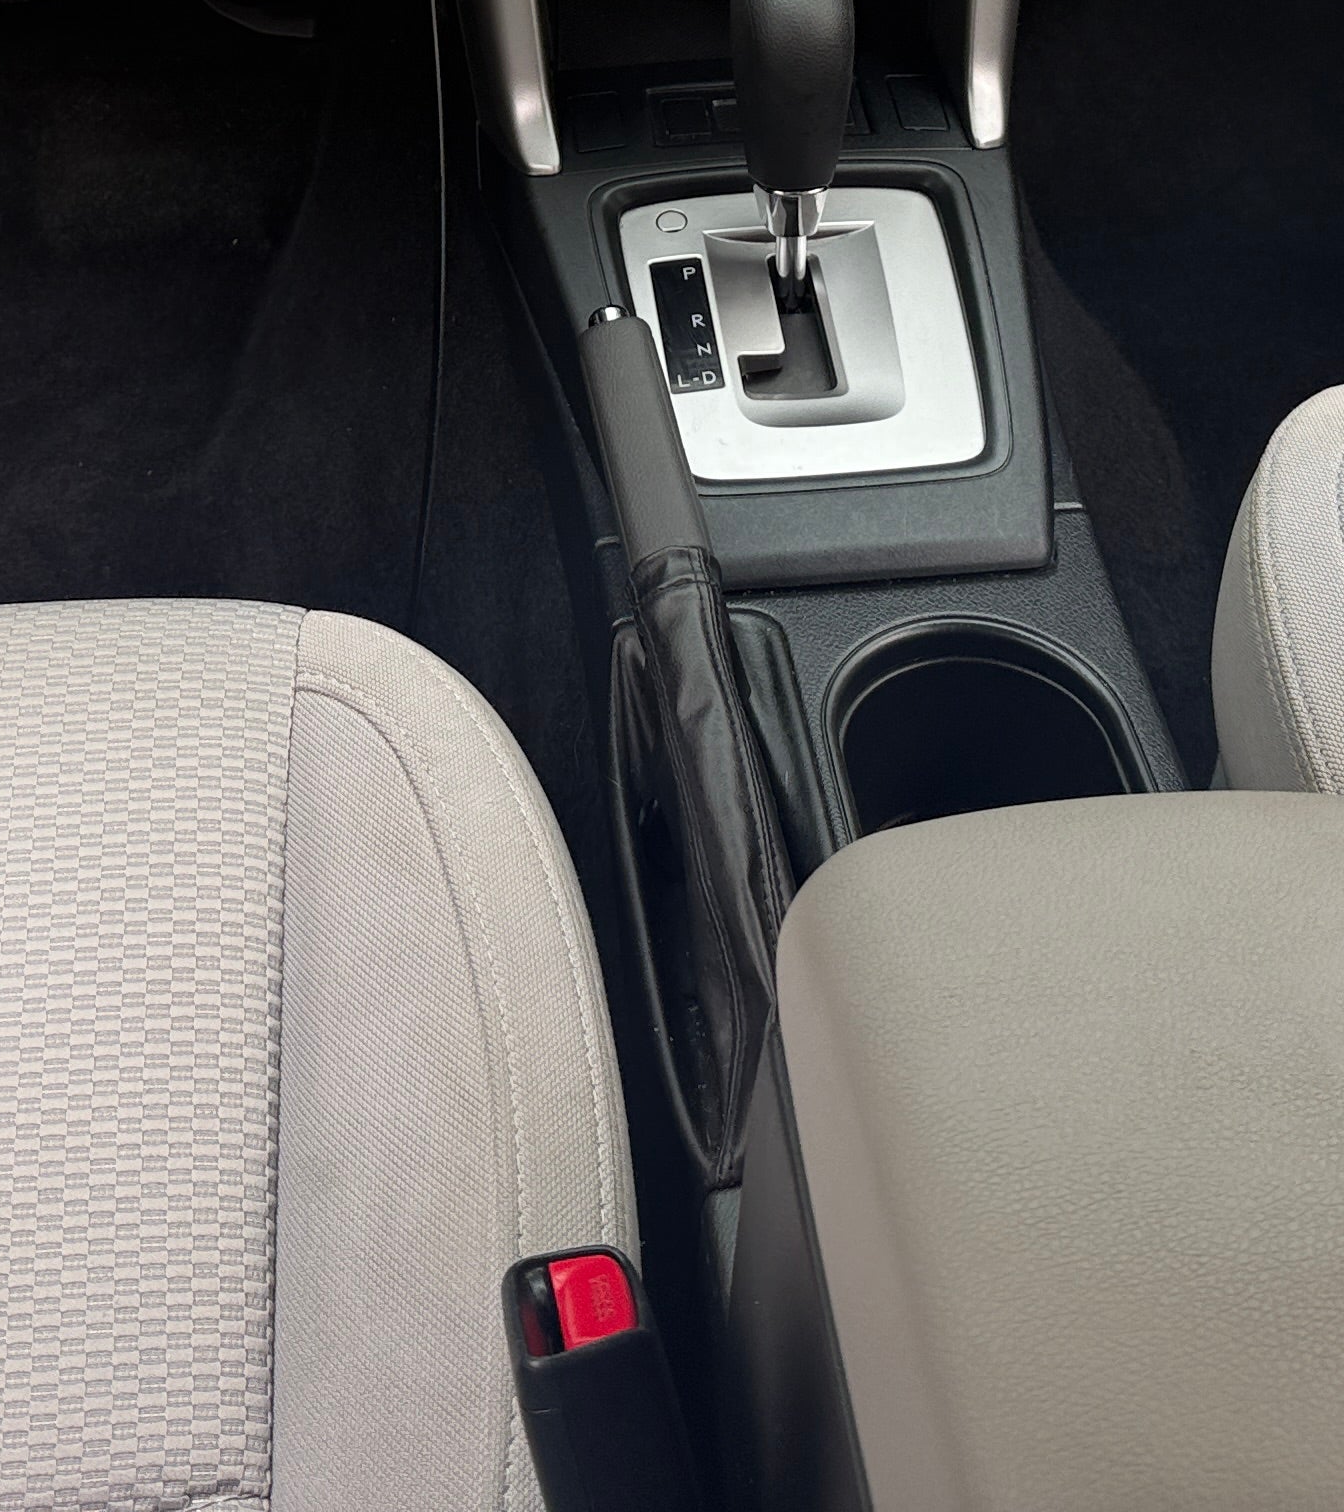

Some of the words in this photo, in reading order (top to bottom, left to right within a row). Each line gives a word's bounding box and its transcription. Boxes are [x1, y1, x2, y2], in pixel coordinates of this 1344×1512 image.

[682, 267, 696, 280] P
[692, 314, 706, 328] R
[697, 342, 712, 356] N
